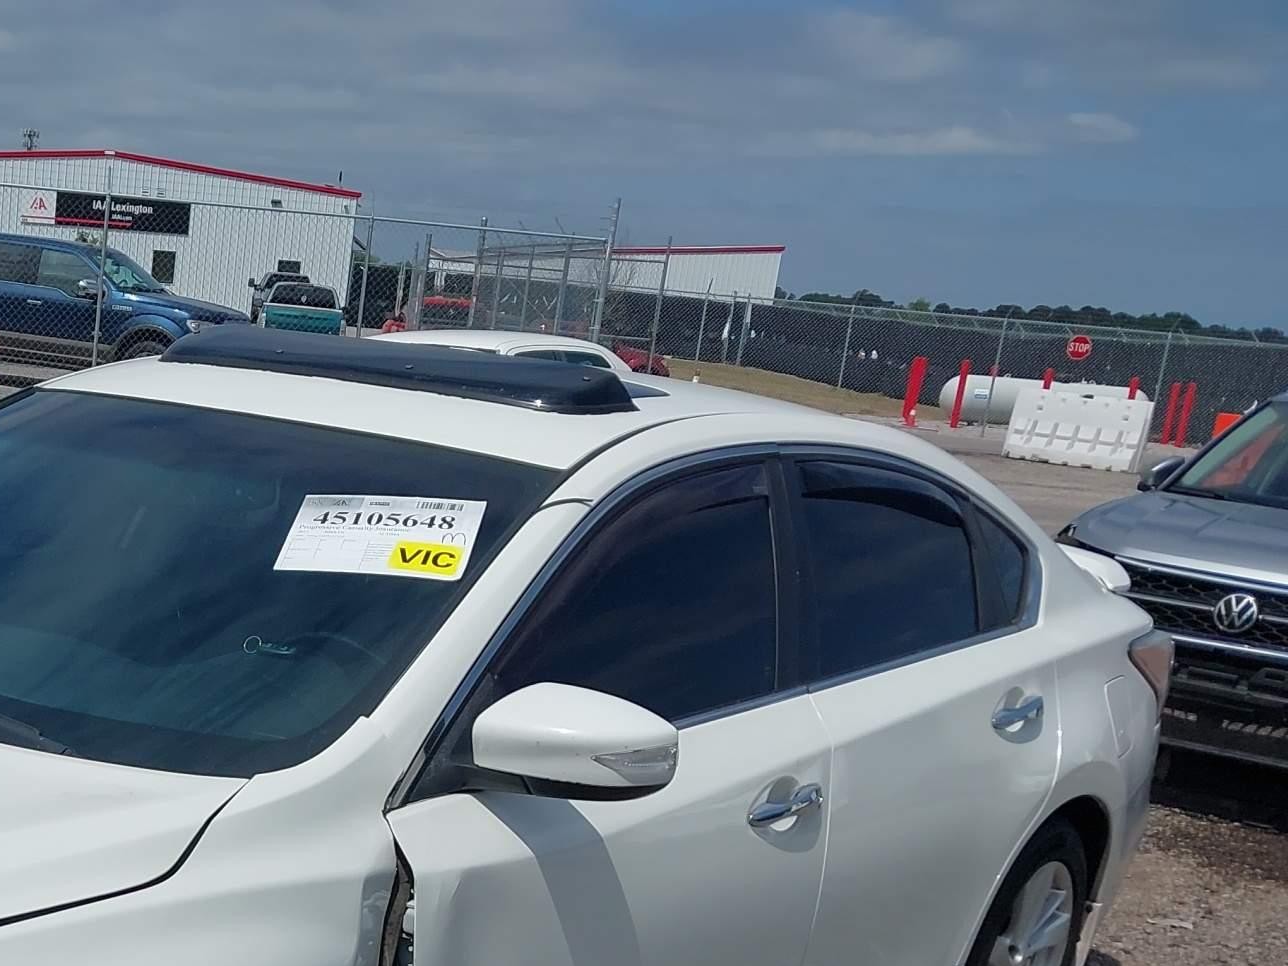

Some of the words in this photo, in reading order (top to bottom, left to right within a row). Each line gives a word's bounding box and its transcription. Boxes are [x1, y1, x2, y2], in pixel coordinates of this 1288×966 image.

[111, 201, 153, 215] Lexington
[1068, 343, 1090, 352] STOP
[313, 511, 456, 530] 45105648
[399, 547, 456, 568] VIC
